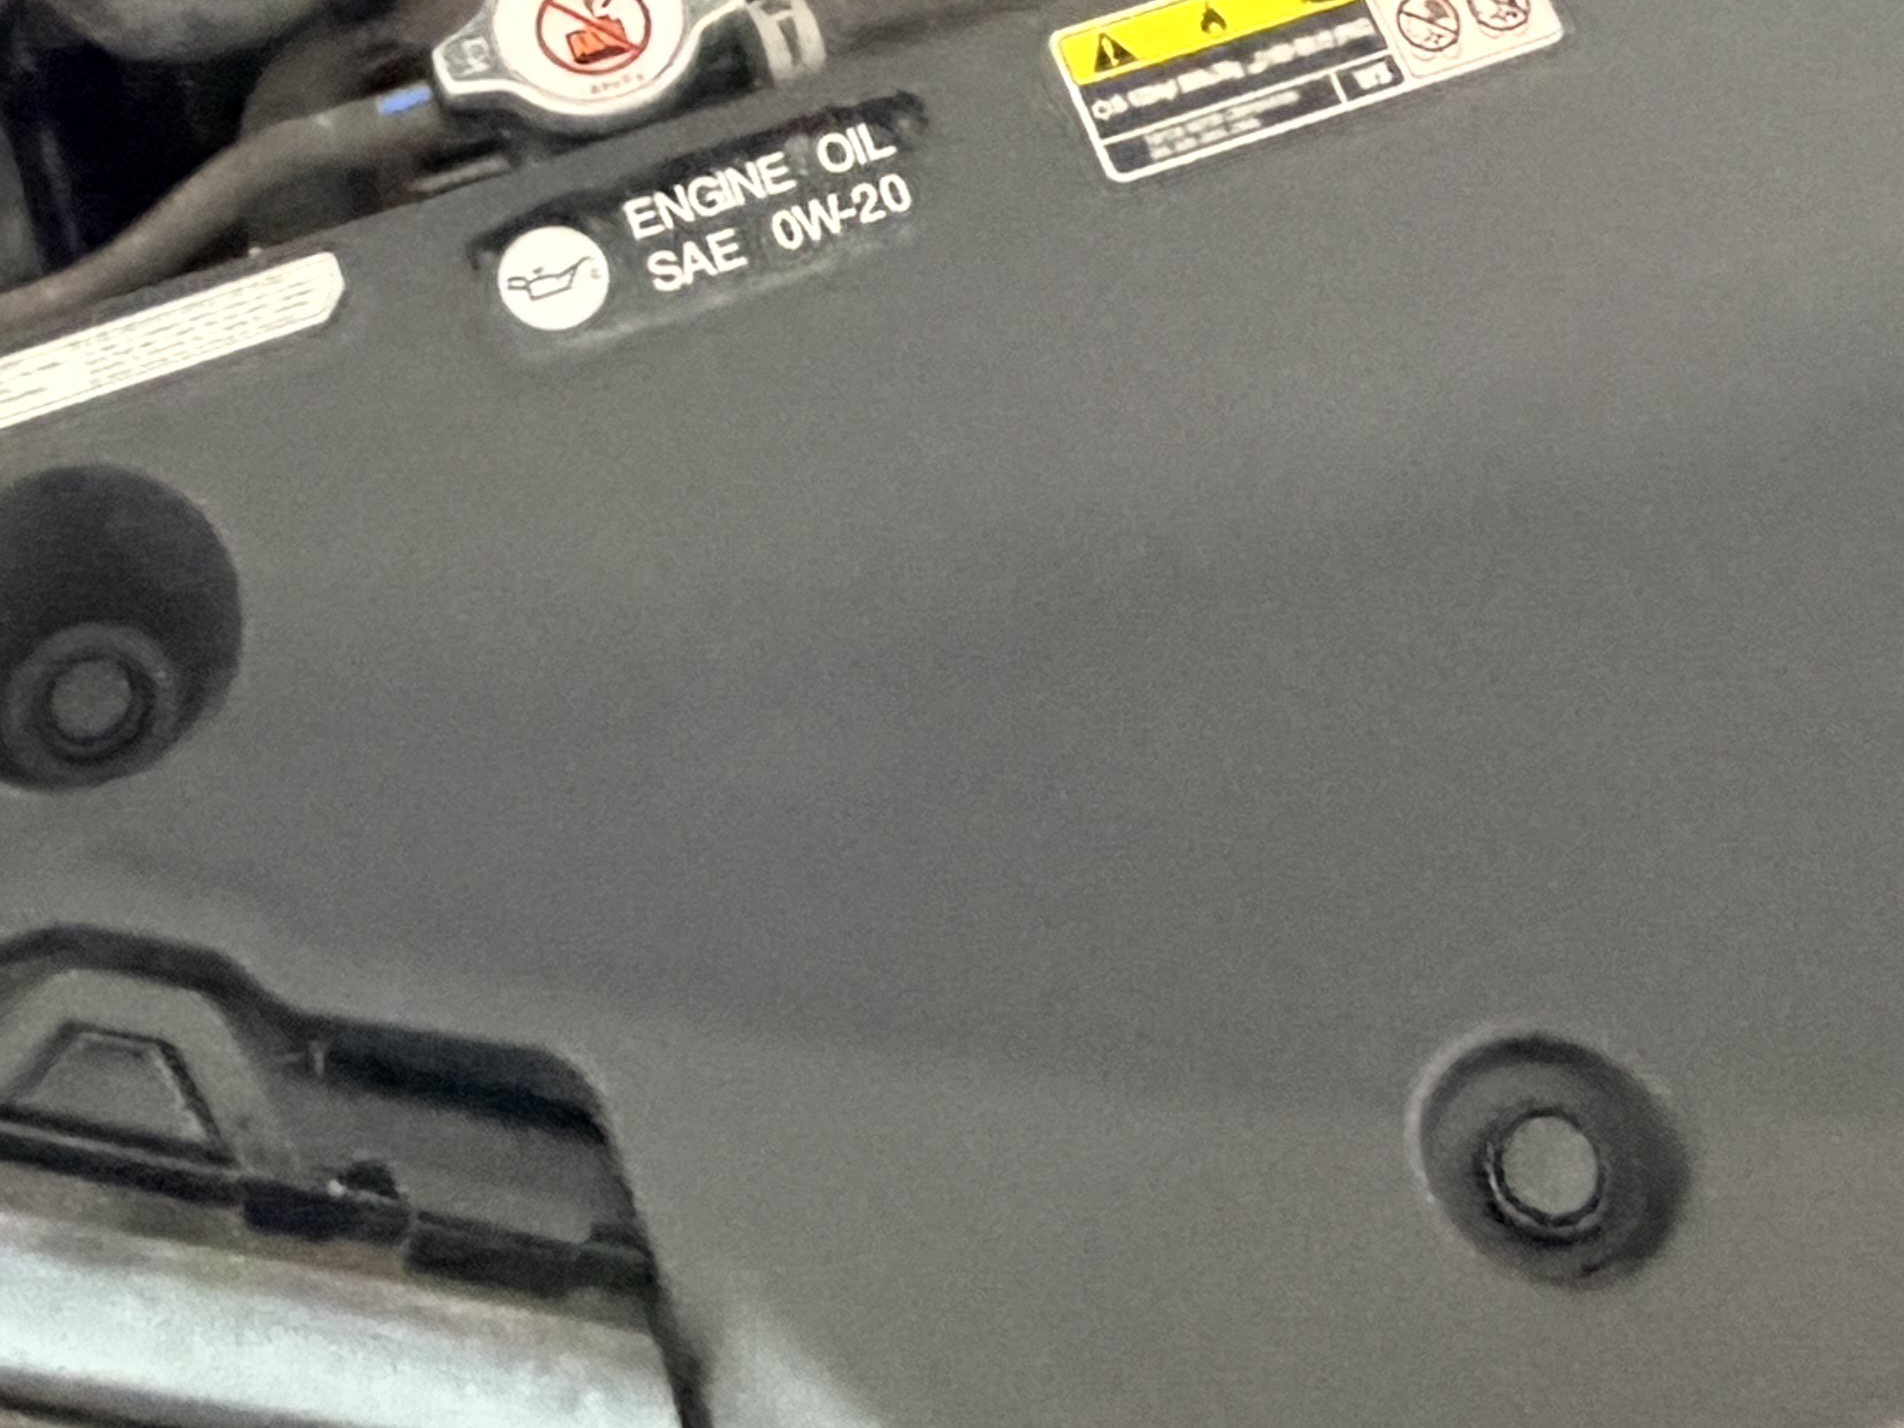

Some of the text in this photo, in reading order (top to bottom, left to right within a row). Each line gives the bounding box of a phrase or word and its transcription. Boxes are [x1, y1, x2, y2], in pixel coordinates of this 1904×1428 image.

[622, 122, 897, 241] ENGINE OIL
[646, 173, 914, 293] SAE 0W-20
